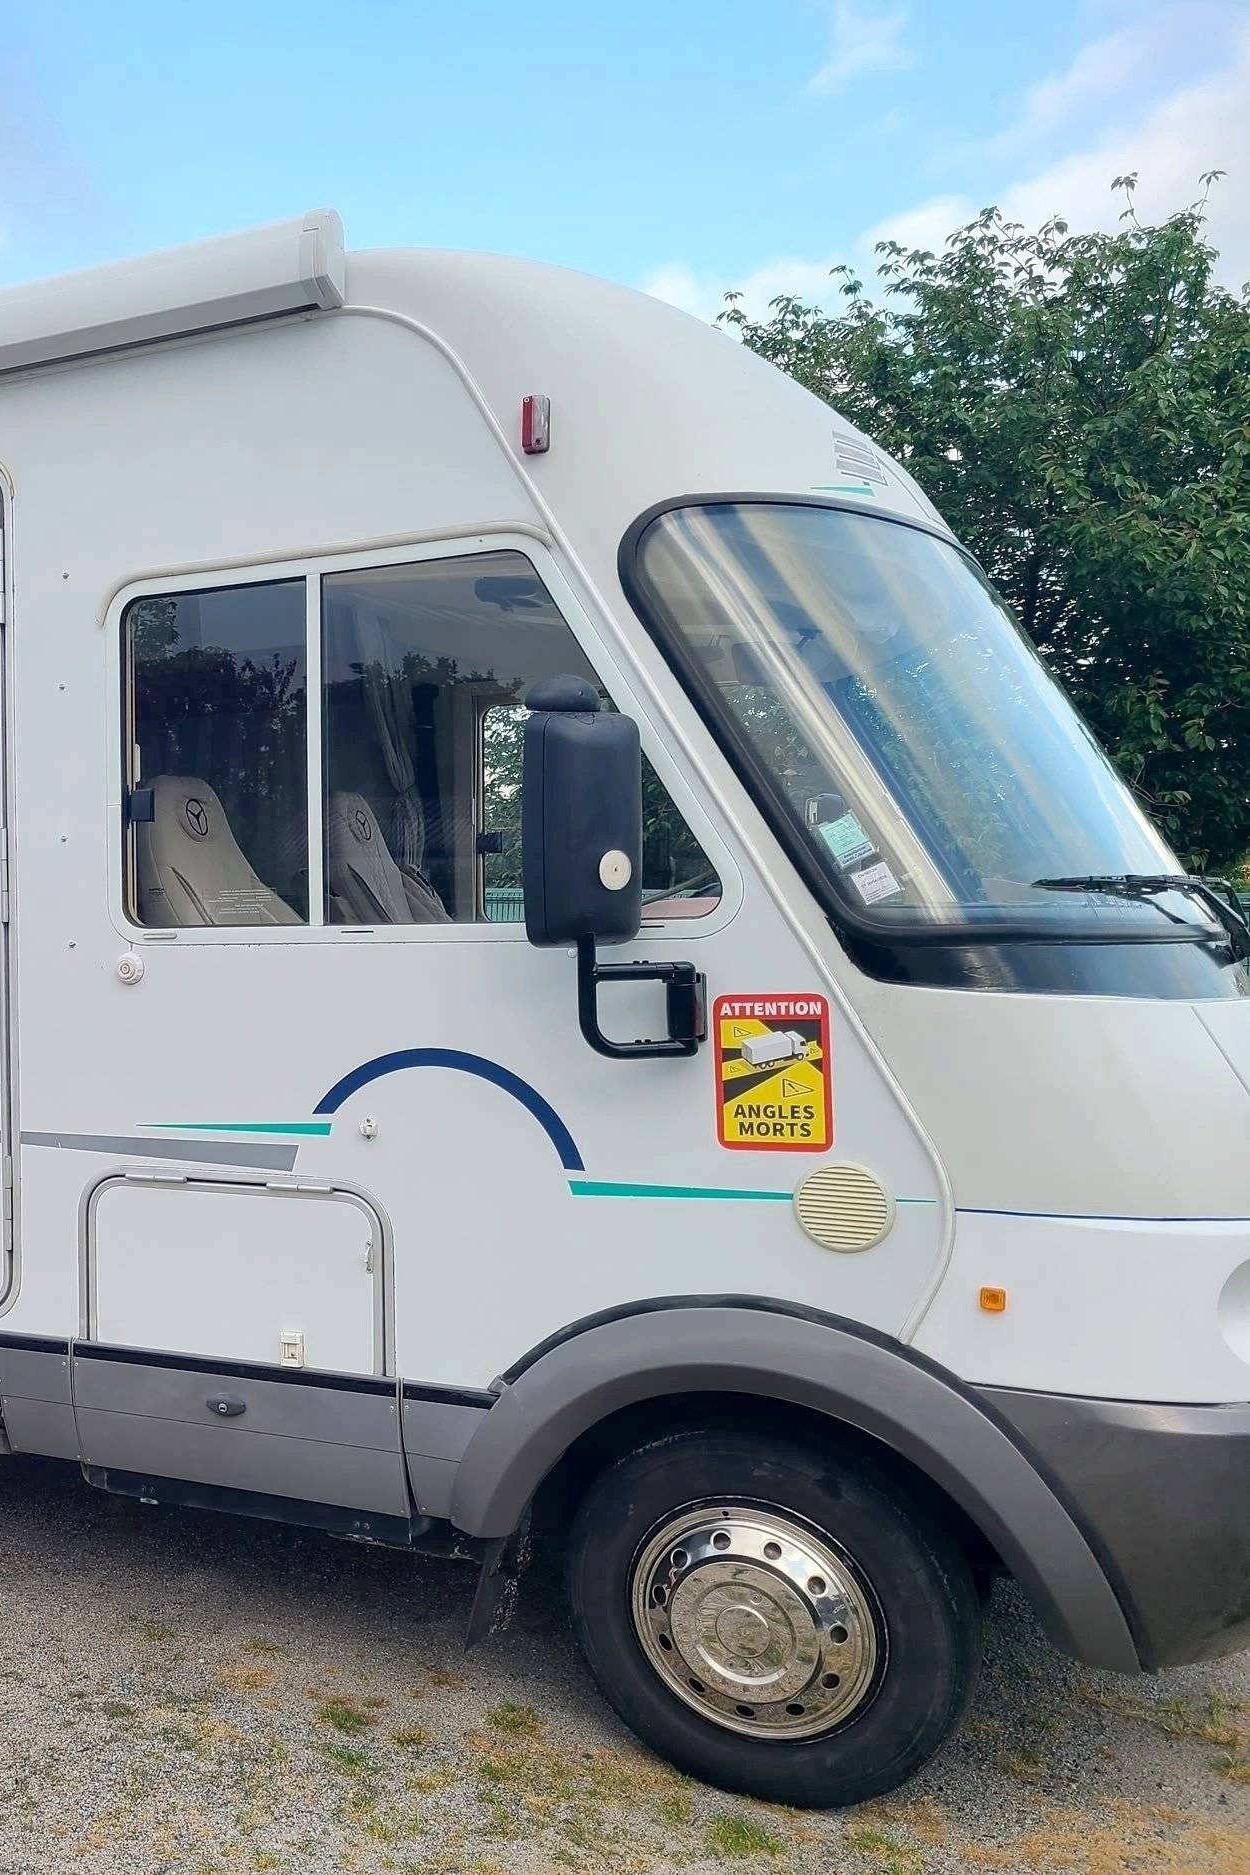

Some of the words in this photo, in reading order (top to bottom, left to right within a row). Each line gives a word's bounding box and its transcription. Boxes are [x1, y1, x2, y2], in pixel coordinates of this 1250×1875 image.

[720, 1001, 822, 1016] ATTENTION
[734, 1104, 815, 1119] ANGLES
[739, 1121, 812, 1137] MORTS
